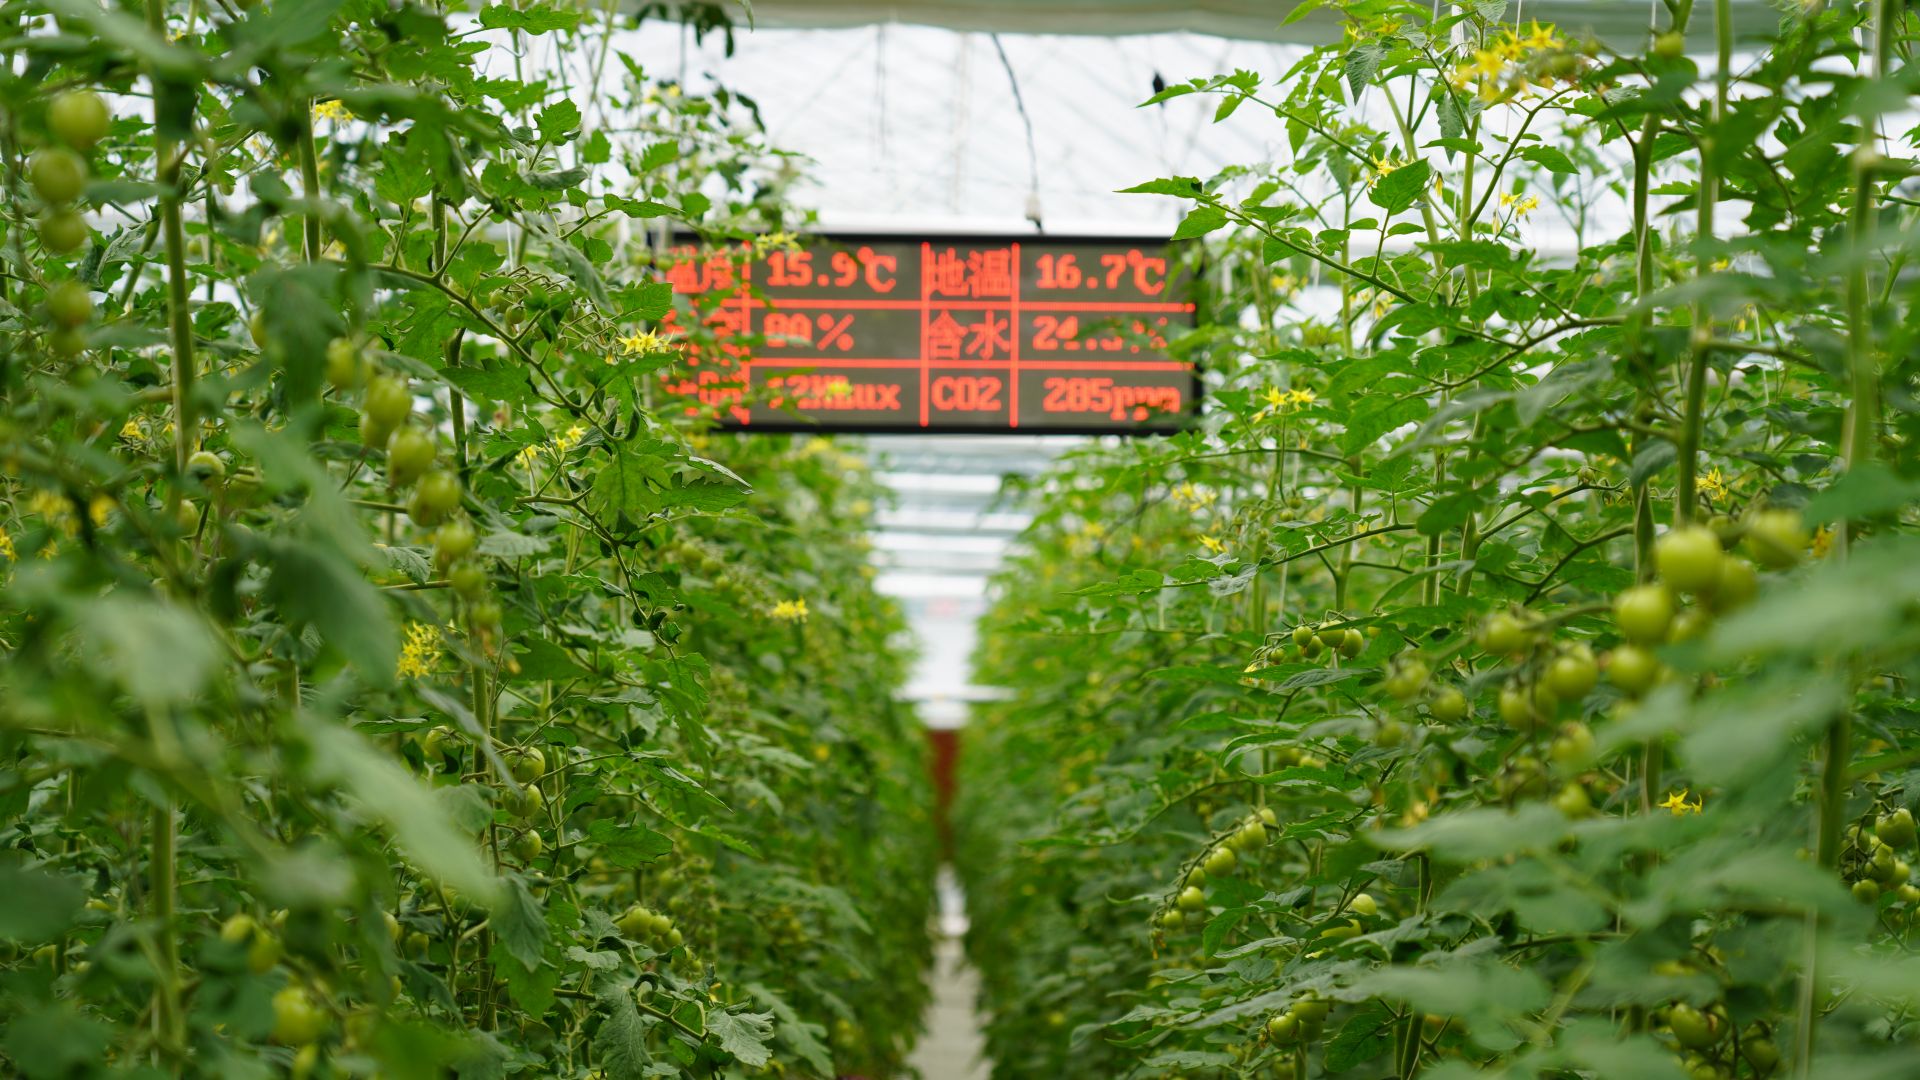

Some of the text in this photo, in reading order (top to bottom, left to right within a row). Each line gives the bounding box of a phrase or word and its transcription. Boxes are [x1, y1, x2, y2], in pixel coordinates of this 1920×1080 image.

[929, 248, 1010, 297] 地温
[929, 311, 1011, 360] 含水
[931, 375, 1002, 411] CO2
